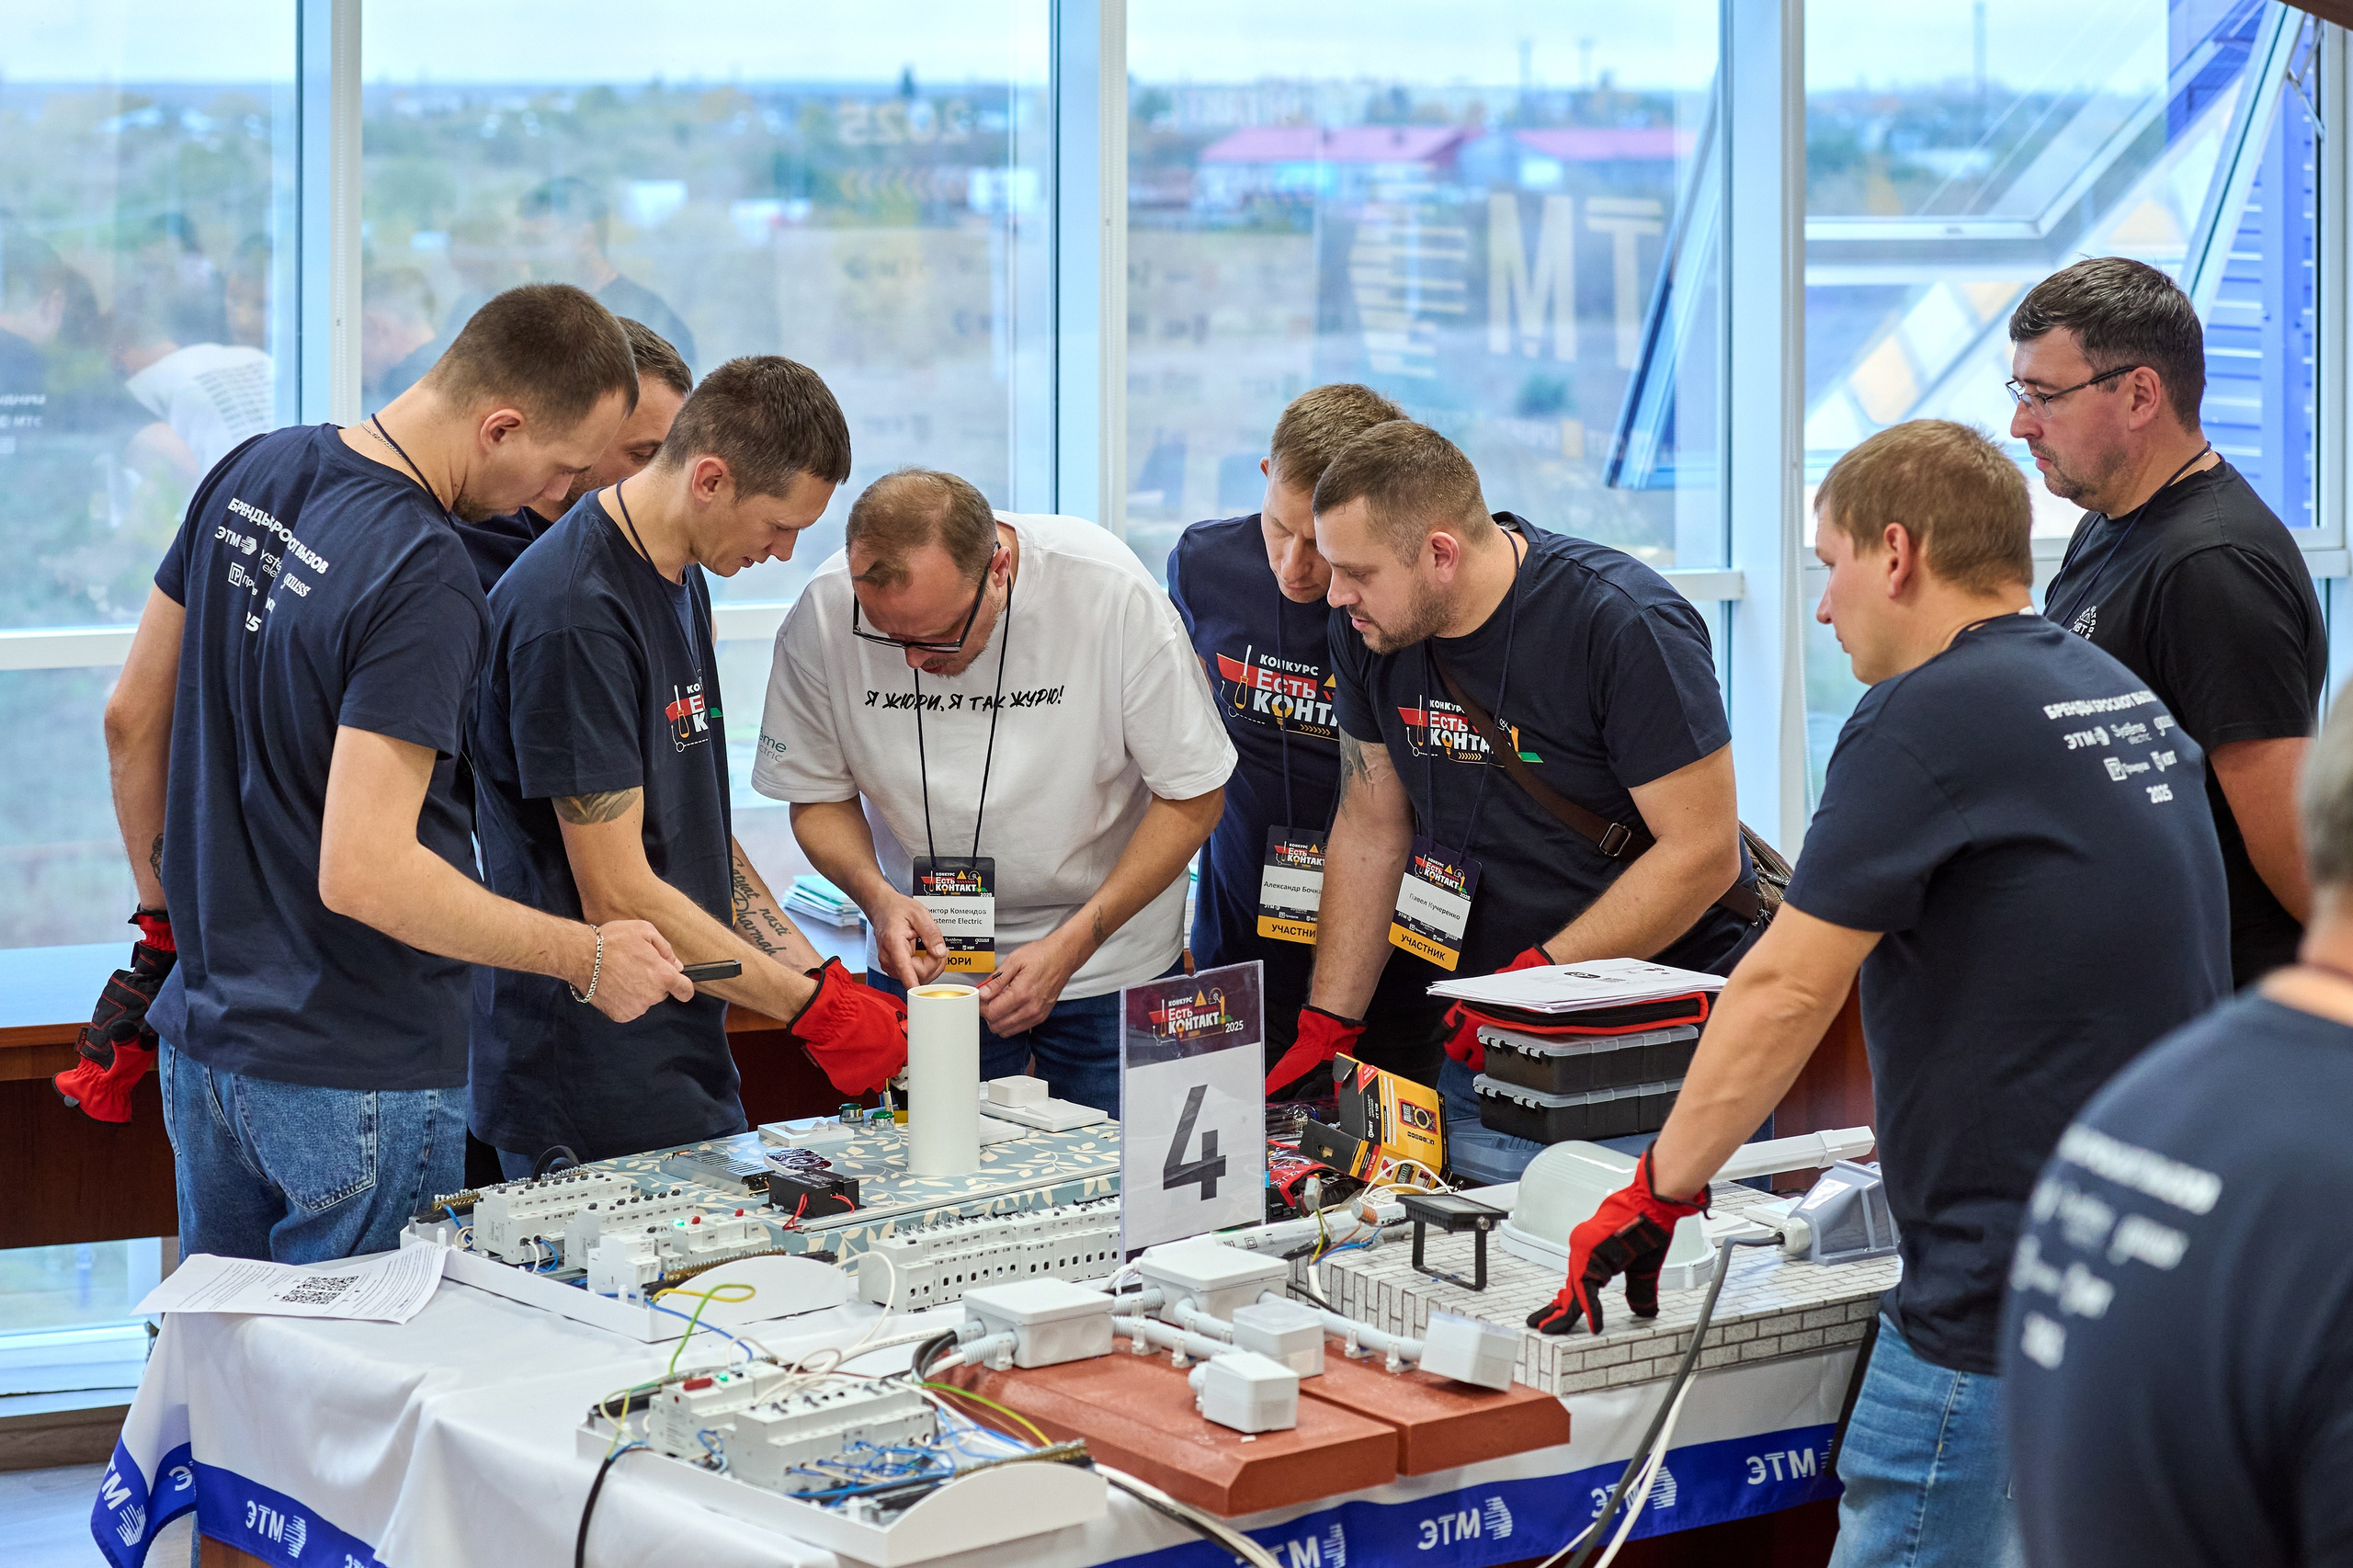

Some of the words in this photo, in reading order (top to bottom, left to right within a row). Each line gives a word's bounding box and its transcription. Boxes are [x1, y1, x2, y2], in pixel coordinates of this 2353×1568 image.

[214, 526, 242, 548] ЭТМ
[1259, 653, 1319, 676] КОНКУРС
[935, 883, 977, 892] КОНТАКТ
[1263, 881, 1302, 893] Александр
[1424, 869, 1460, 889] КОНТАКТ
[957, 917, 983, 926] Electric
[1271, 923, 1316, 938] УЧАСТНИ
[1400, 933, 1446, 961] УЧАСТНИК
[947, 957, 972, 966] ЮРИ
[1168, 996, 1193, 1006] КОНКУРС
[1168, 1011, 1219, 1035] КОНТАКТ
[1225, 1020, 1244, 1034] 2025
[1163, 1084, 1226, 1201] 4
[1745, 1448, 1816, 1485] ЭТМ
[245, 1499, 287, 1543] ЭТМ
[1417, 1507, 1481, 1551] ЭТМ
